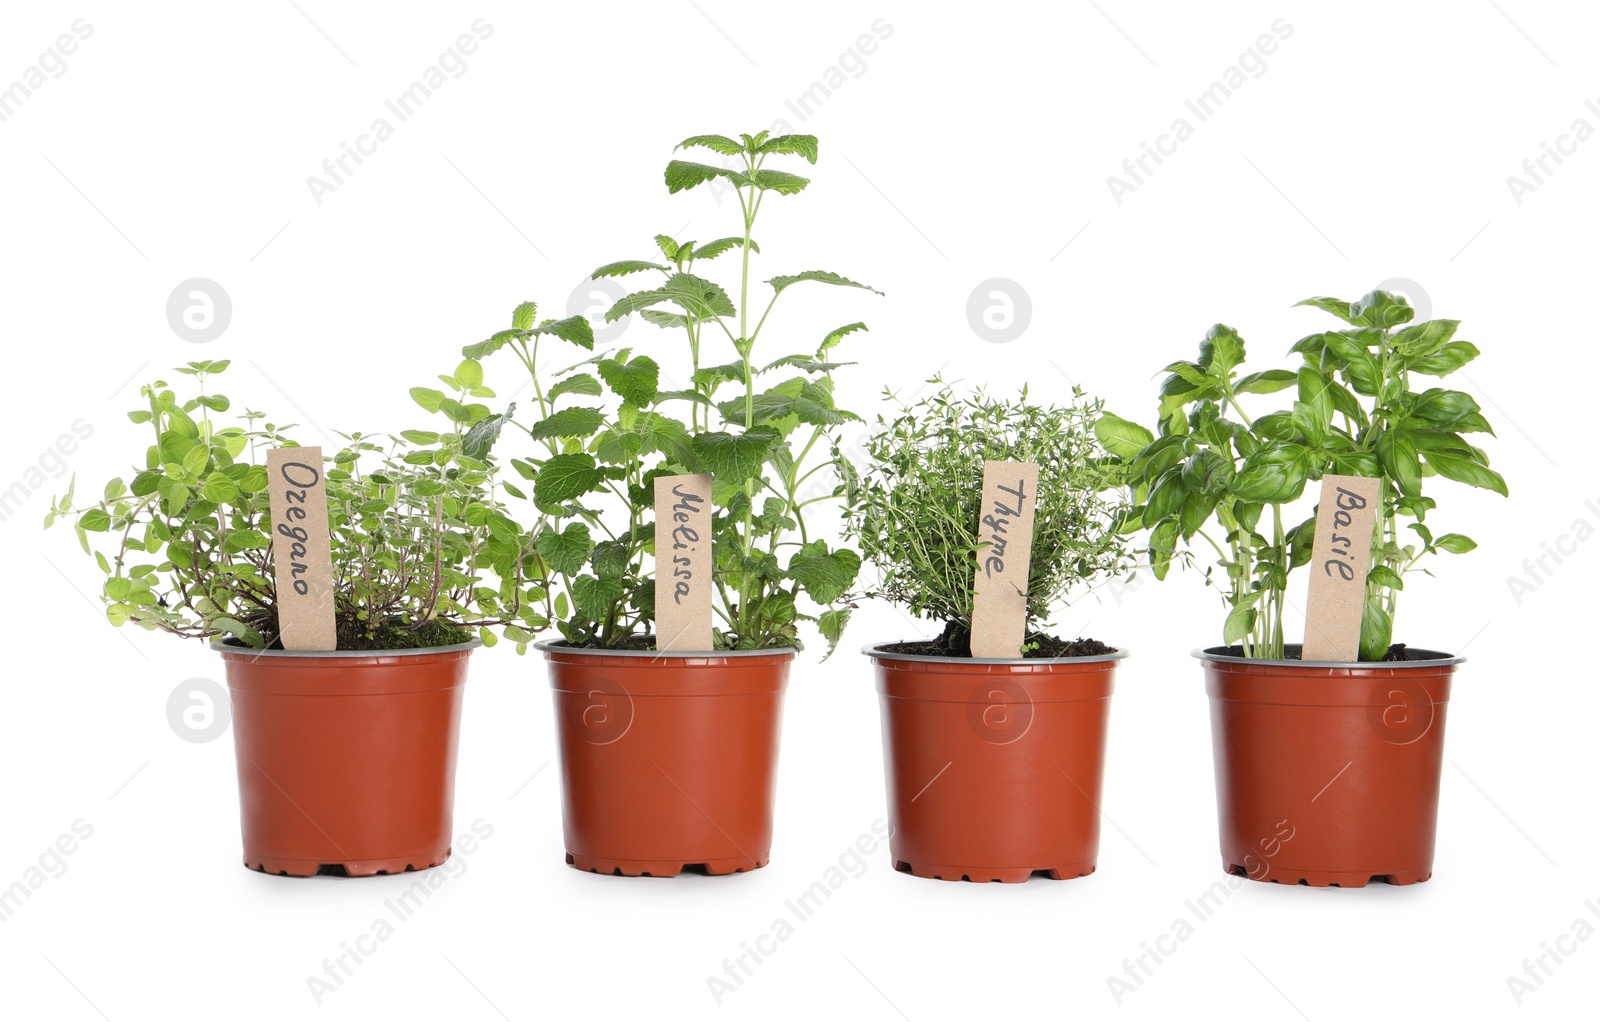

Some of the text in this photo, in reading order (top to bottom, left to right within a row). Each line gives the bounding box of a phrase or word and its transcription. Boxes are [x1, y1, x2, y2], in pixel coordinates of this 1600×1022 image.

[672, 484, 704, 605] Melissa
[982, 479, 1027, 579] Thyme
[1324, 486, 1368, 581] Basil
